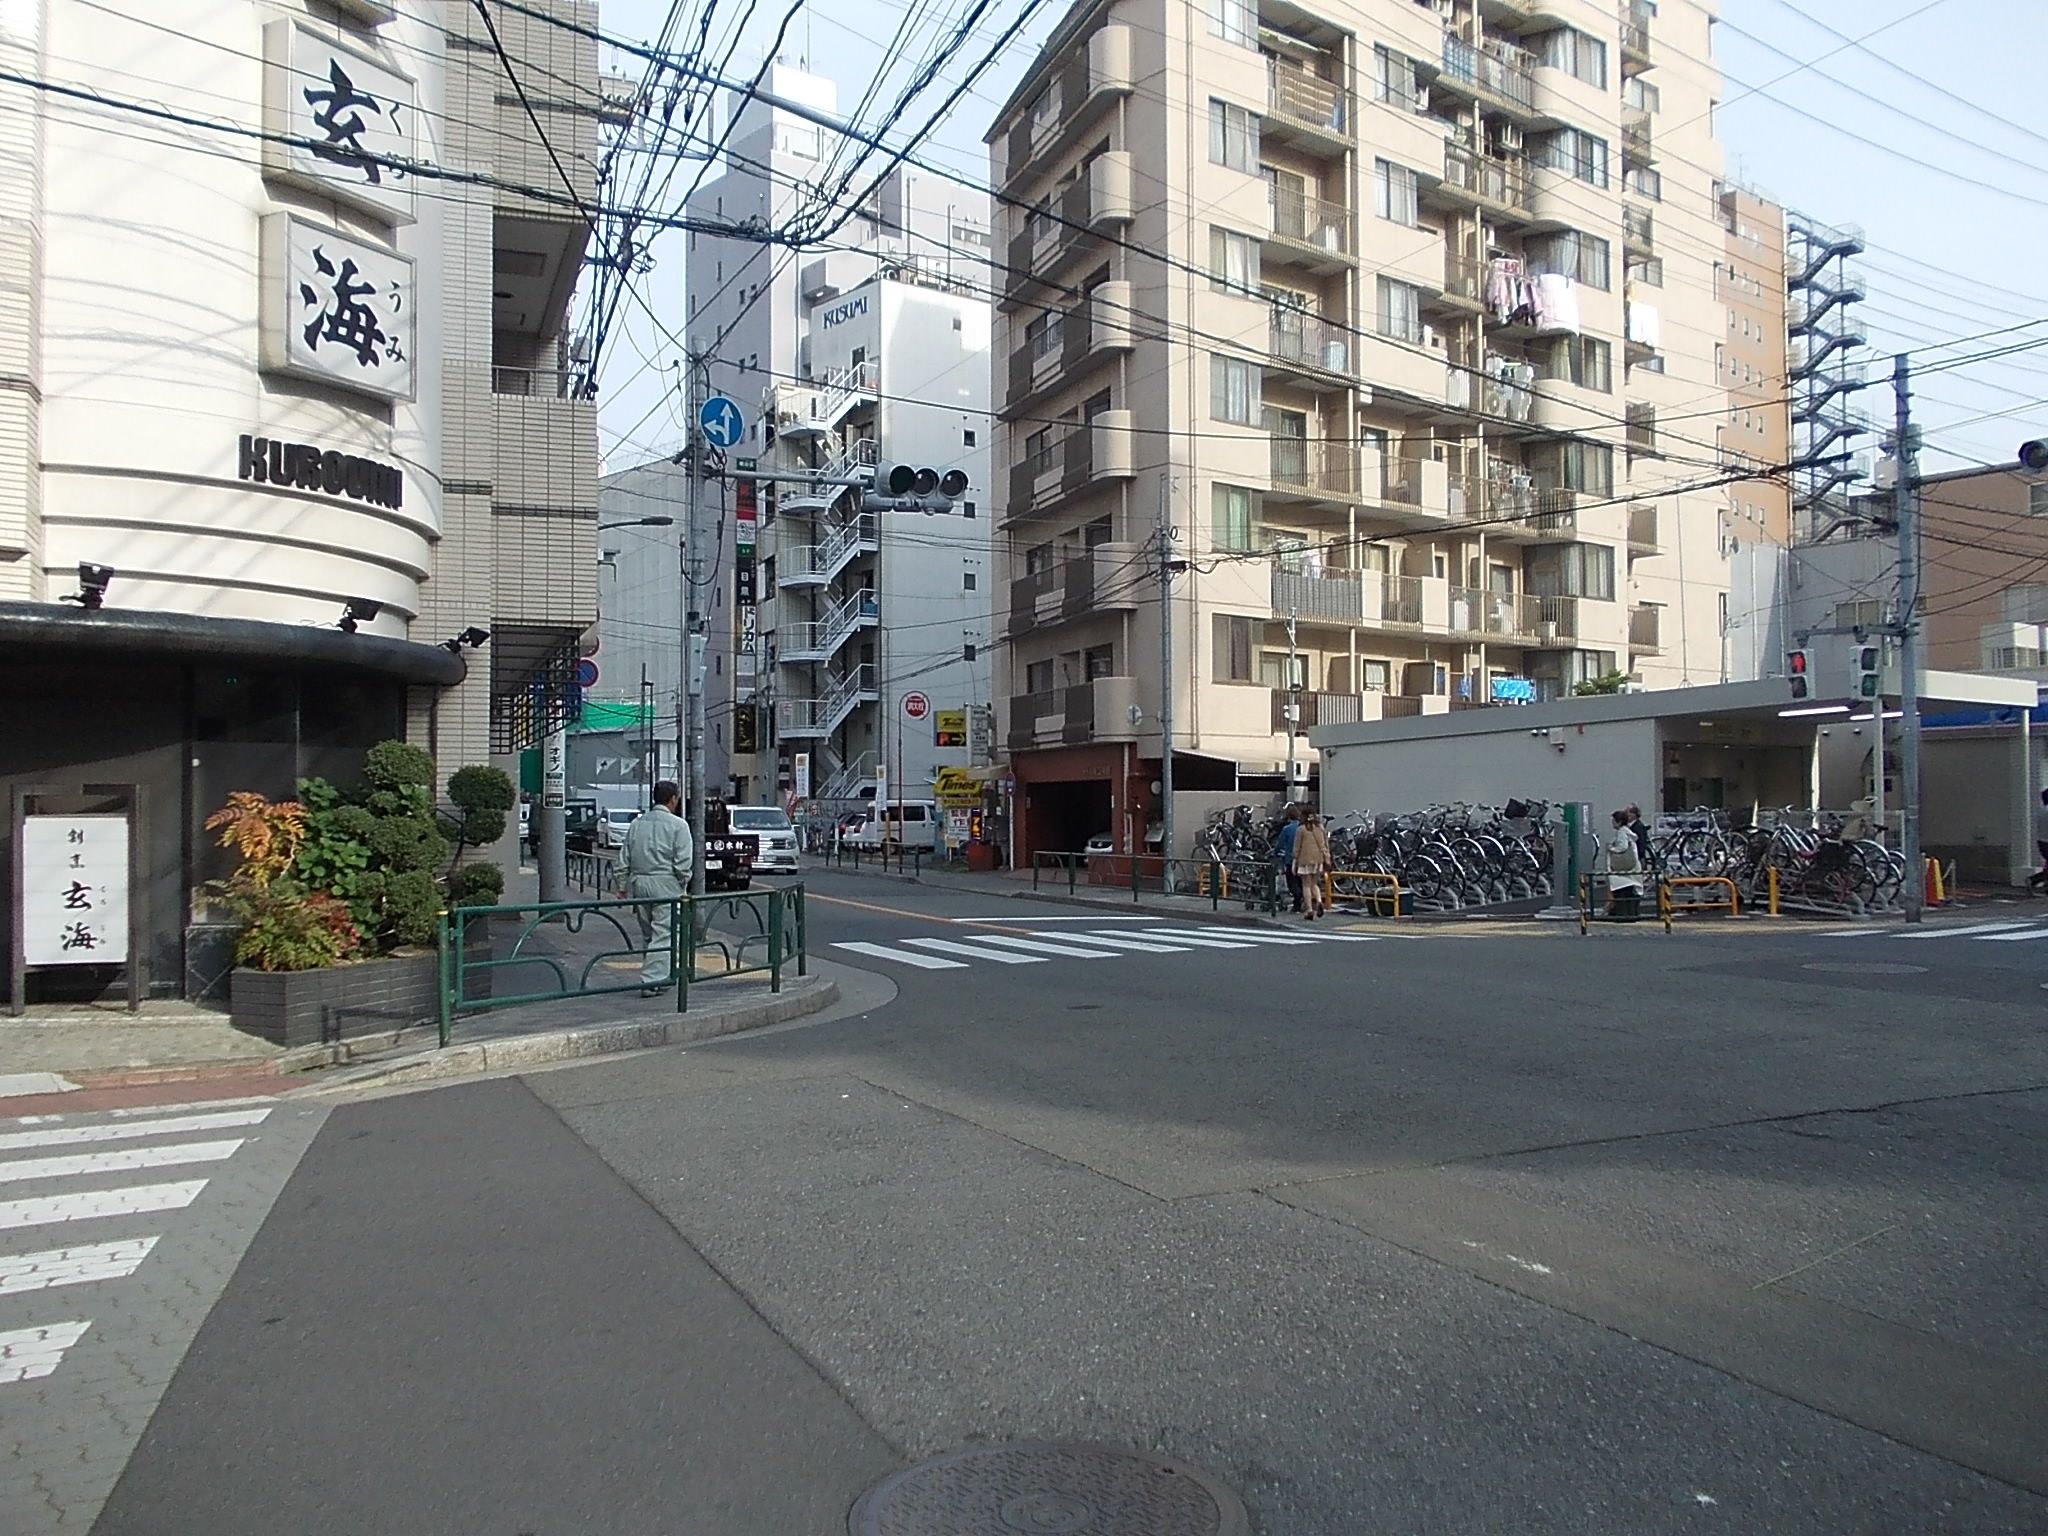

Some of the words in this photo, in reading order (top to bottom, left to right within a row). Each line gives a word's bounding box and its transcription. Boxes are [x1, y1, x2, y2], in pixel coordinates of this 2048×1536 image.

[303, 57, 382, 185] 玄
[300, 243, 388, 368] 海
[389, 279, 407, 364] うみ
[823, 296, 868, 329] KUSUMI
[238, 434, 403, 512] KUROUMI
[743, 607, 755, 654] ドリカム
[907, 702, 925, 711] 消火栓
[941, 773, 977, 792] Times
[60, 880, 98, 951] 玄海
